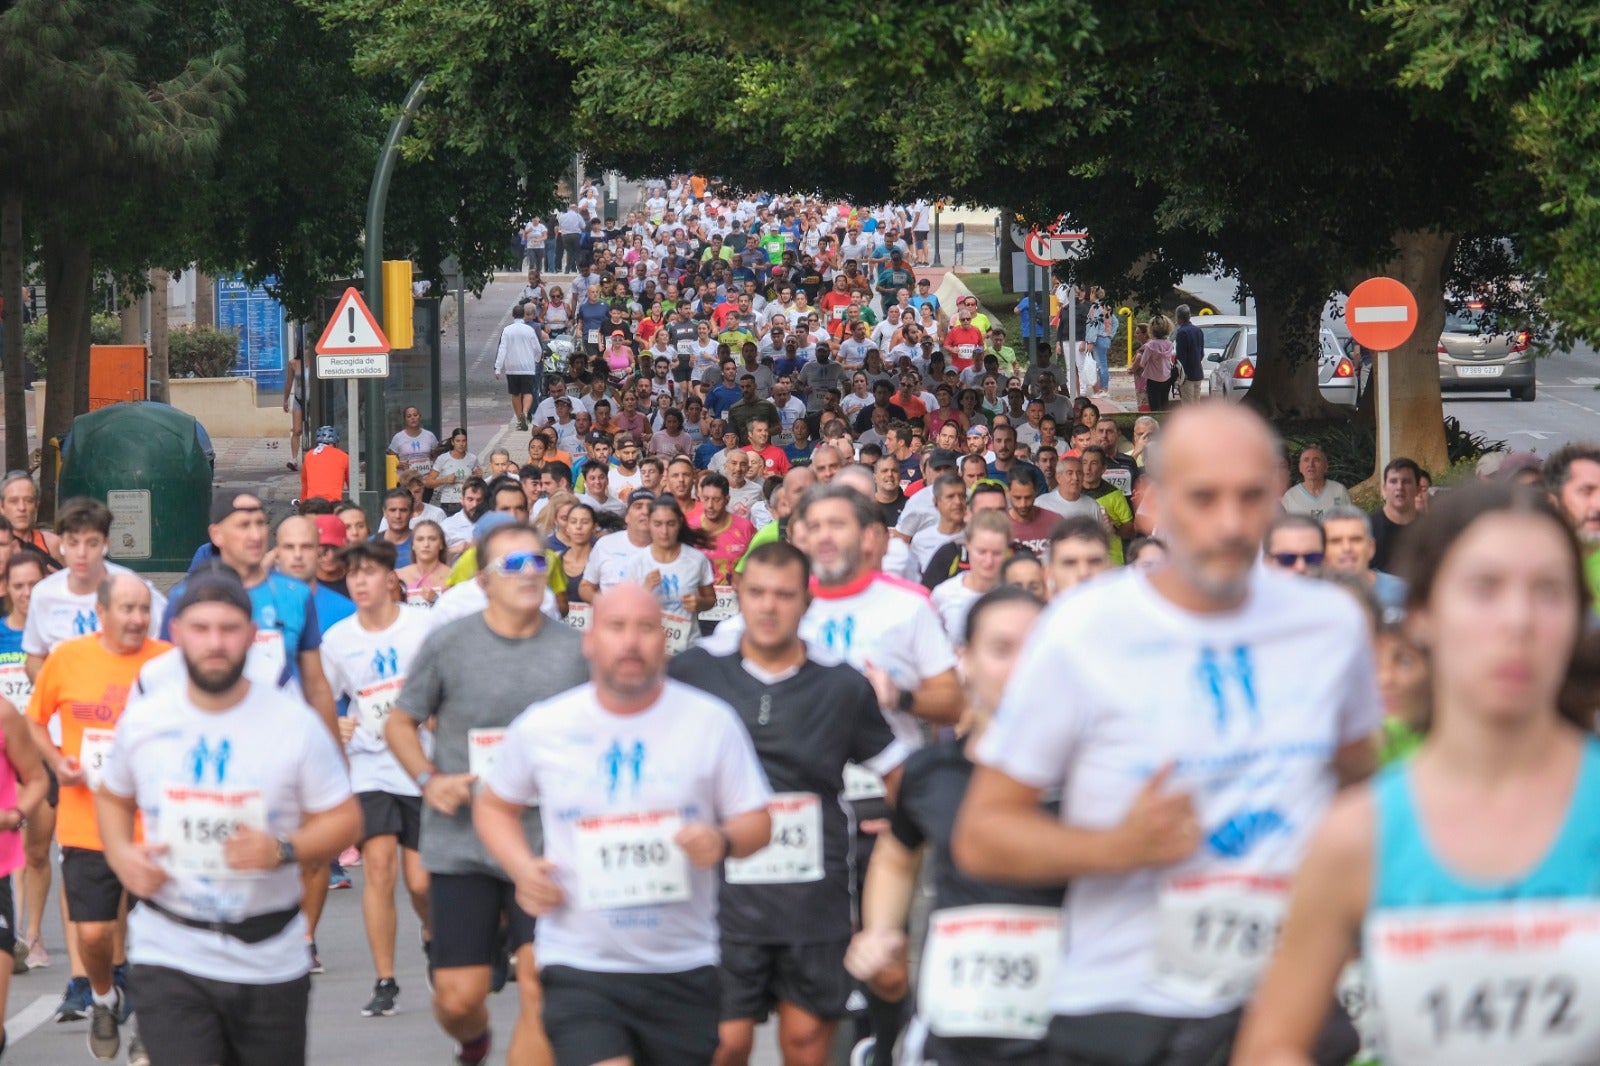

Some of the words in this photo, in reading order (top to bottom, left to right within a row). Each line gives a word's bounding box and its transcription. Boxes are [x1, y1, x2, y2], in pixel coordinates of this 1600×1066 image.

[324, 367, 355, 375] residuos
[356, 366, 382, 374] solidos
[330, 358, 364, 367] Recogida
[365, 357, 375, 365] de
[597, 838, 670, 869] 1780
[948, 952, 1040, 990] 1799
[1422, 973, 1580, 1044] 1472
